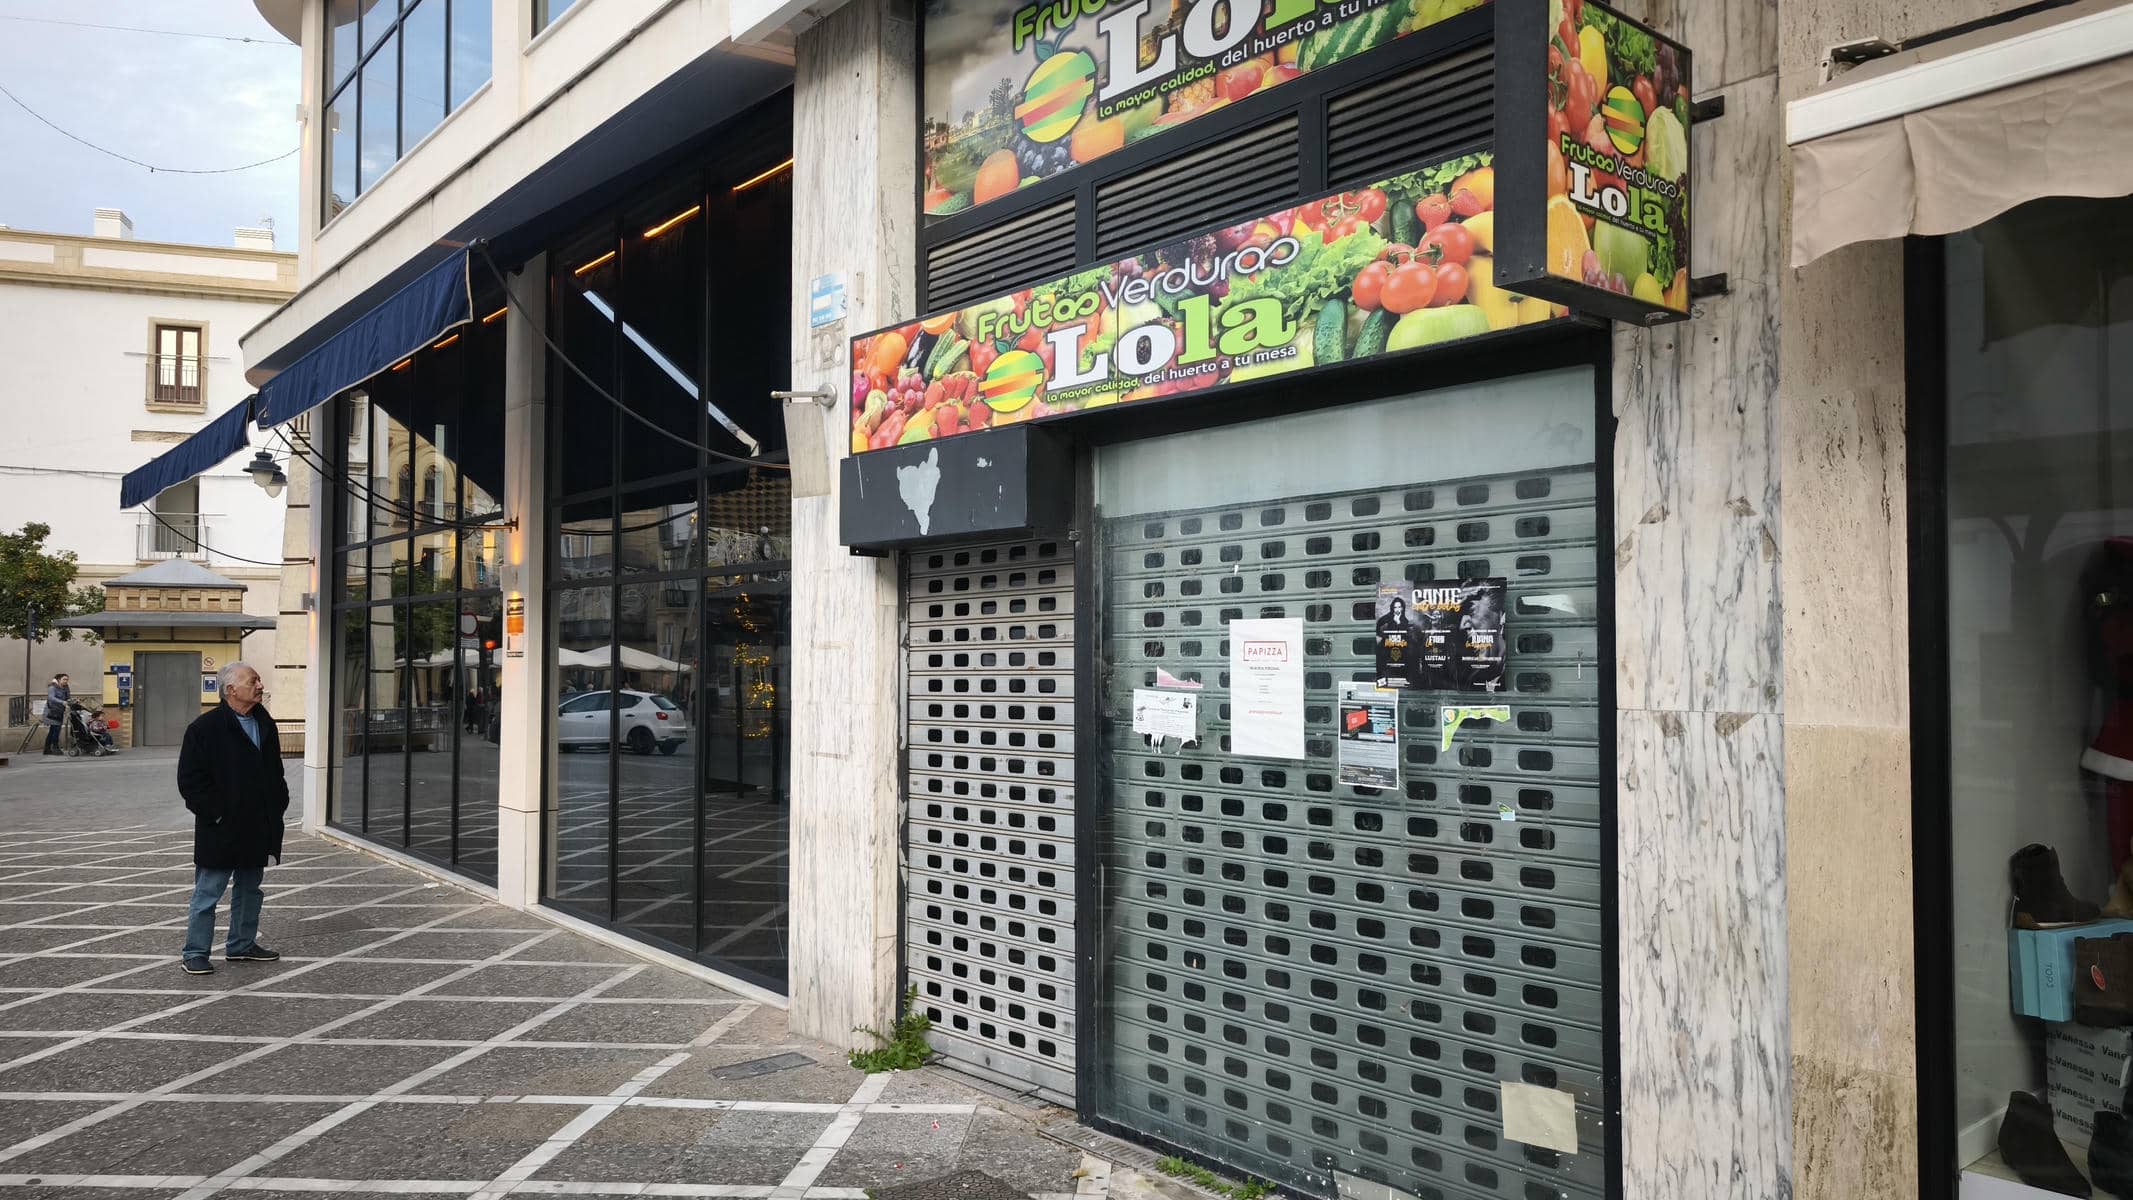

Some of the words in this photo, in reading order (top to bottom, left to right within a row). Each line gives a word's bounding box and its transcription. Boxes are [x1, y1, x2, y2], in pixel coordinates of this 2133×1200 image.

[1100, 107, 1112, 118] la
[1116, 87, 1157, 112] mayor
[1160, 60, 1216, 93] calidad,
[1221, 43, 1249, 67] del
[1253, 19, 1315, 54] huerto
[1321, 13, 1333, 25] a
[1339, 0, 1359, 18] tu
[1561, 133, 1616, 173] Frutas
[1613, 157, 1677, 198] Verduras
[1569, 161, 1669, 234] Lola
[978, 291, 1100, 343] Frutas
[1100, 237, 1300, 309] Verduras
[1046, 294, 1297, 392] Lola
[1046, 392, 1057, 402] la
[1058, 386, 1094, 401] mayor
[1095, 377, 1141, 393] calidad,
[1144, 371, 1165, 385] del
[1169, 361, 1217, 382] huerto
[1221, 359, 1230, 369] a
[1234, 355, 1250, 367] tu
[1255, 346, 1297, 363] mesa
[1411, 588, 1461, 605] CANTE
[1247, 647, 1283, 656] PAPIZZA
[2055, 1030, 2095, 1051] Vanessa
[2055, 1055, 2095, 1078] Vanessa
[2055, 1081, 2096, 1104] Vanessa
